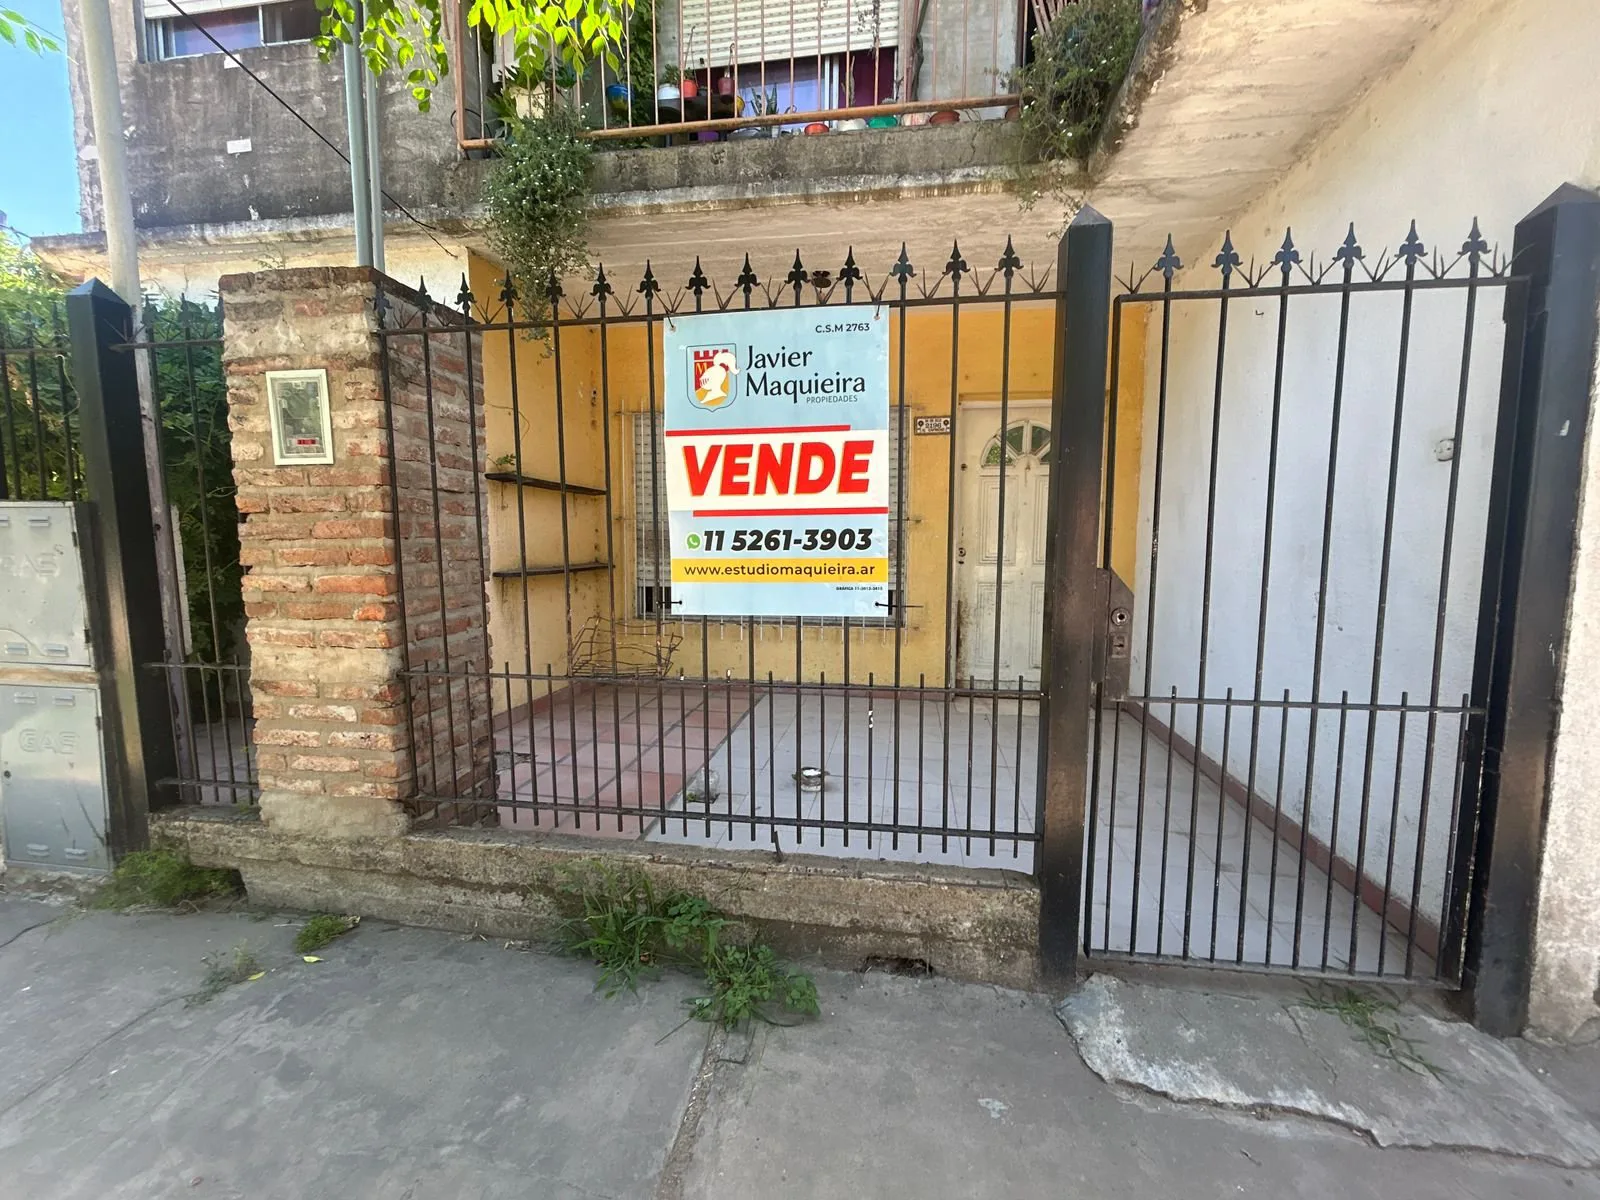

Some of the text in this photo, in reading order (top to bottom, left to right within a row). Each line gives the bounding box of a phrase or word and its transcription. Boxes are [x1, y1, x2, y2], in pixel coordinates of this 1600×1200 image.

[815, 322, 870, 333] C.S.M 2763
[745, 345, 813, 371] Javier
[745, 371, 866, 404] Maquieira
[806, 394, 858, 404] PROPIEDADES
[682, 440, 874, 497] VENDE
[703, 528, 873, 551] 11 5261-3903
[684, 563, 876, 577] www.estudiomaquieira.ar
